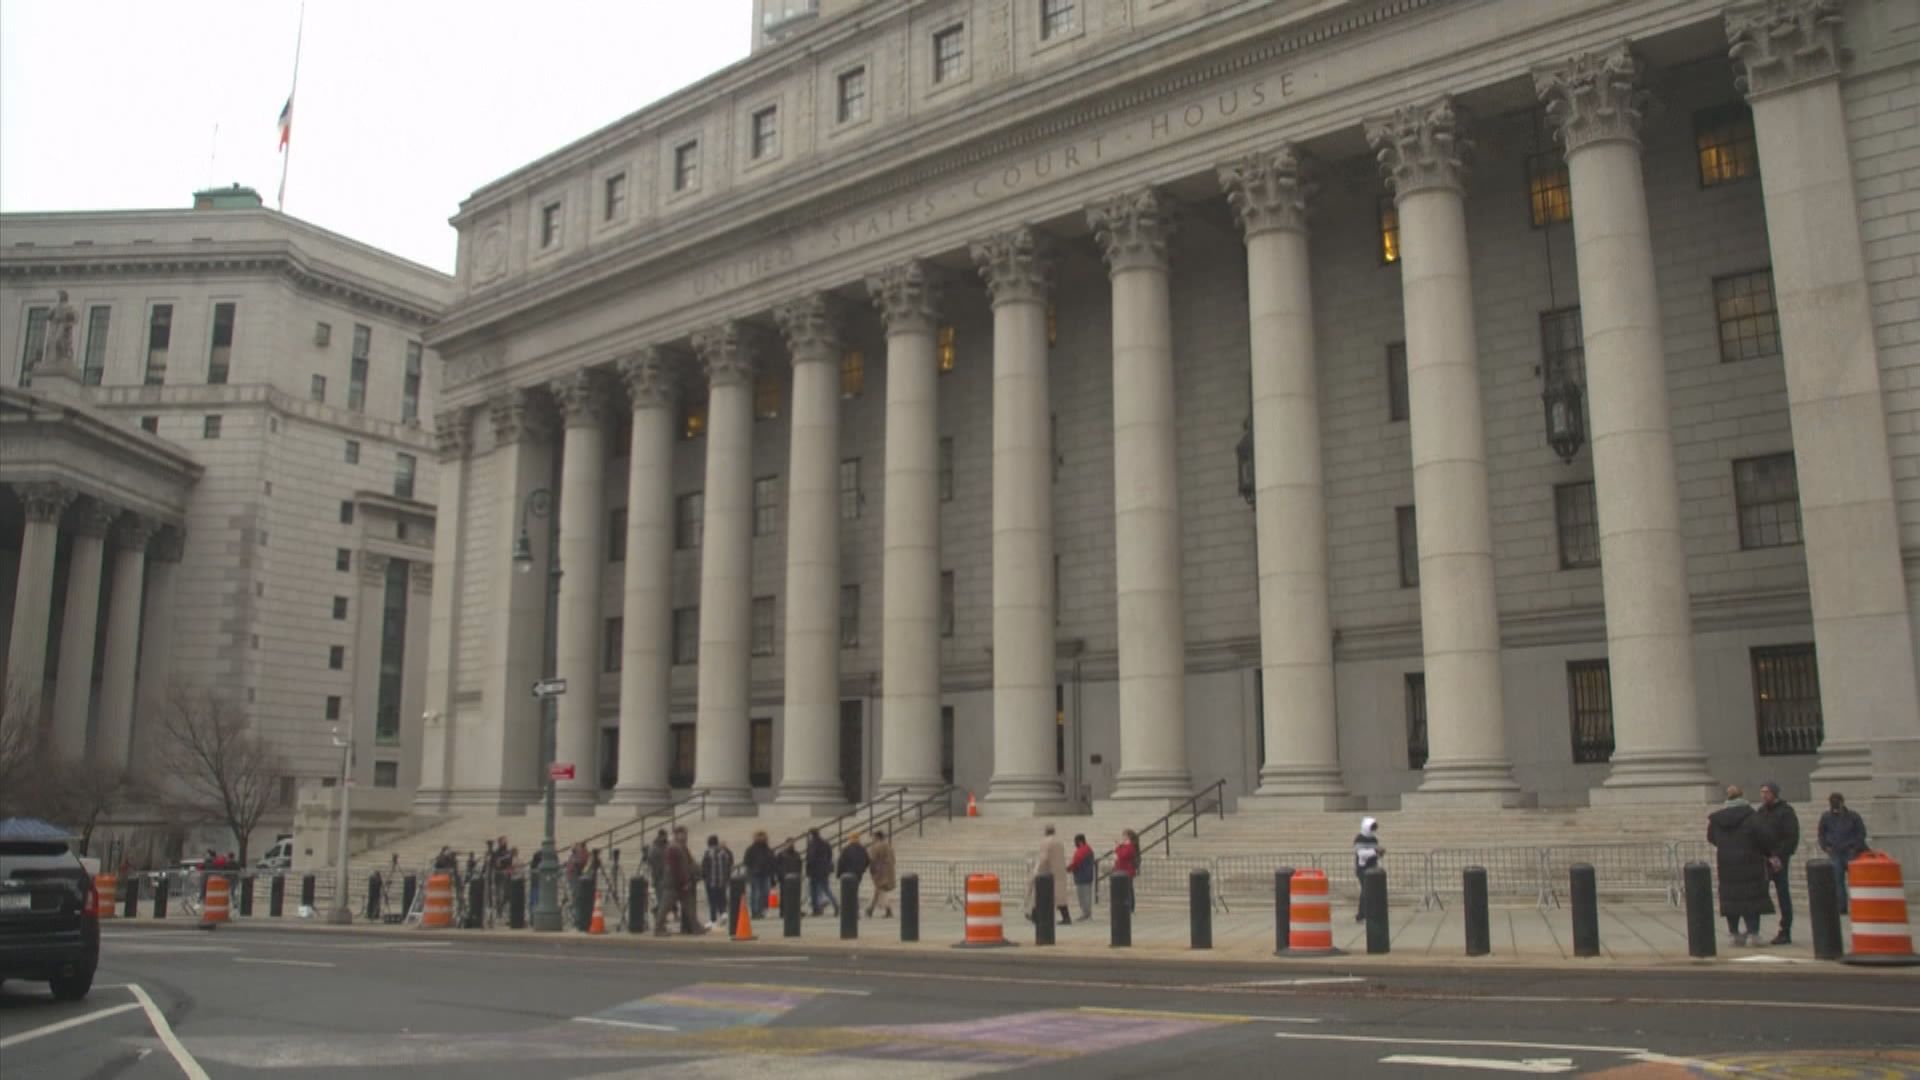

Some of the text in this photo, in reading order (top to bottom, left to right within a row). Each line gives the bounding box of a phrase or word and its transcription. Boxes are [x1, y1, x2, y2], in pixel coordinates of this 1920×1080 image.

[831, 198, 935, 250] STATES
[973, 136, 1104, 199] COURT
[1151, 71, 1295, 139] HOUSE
